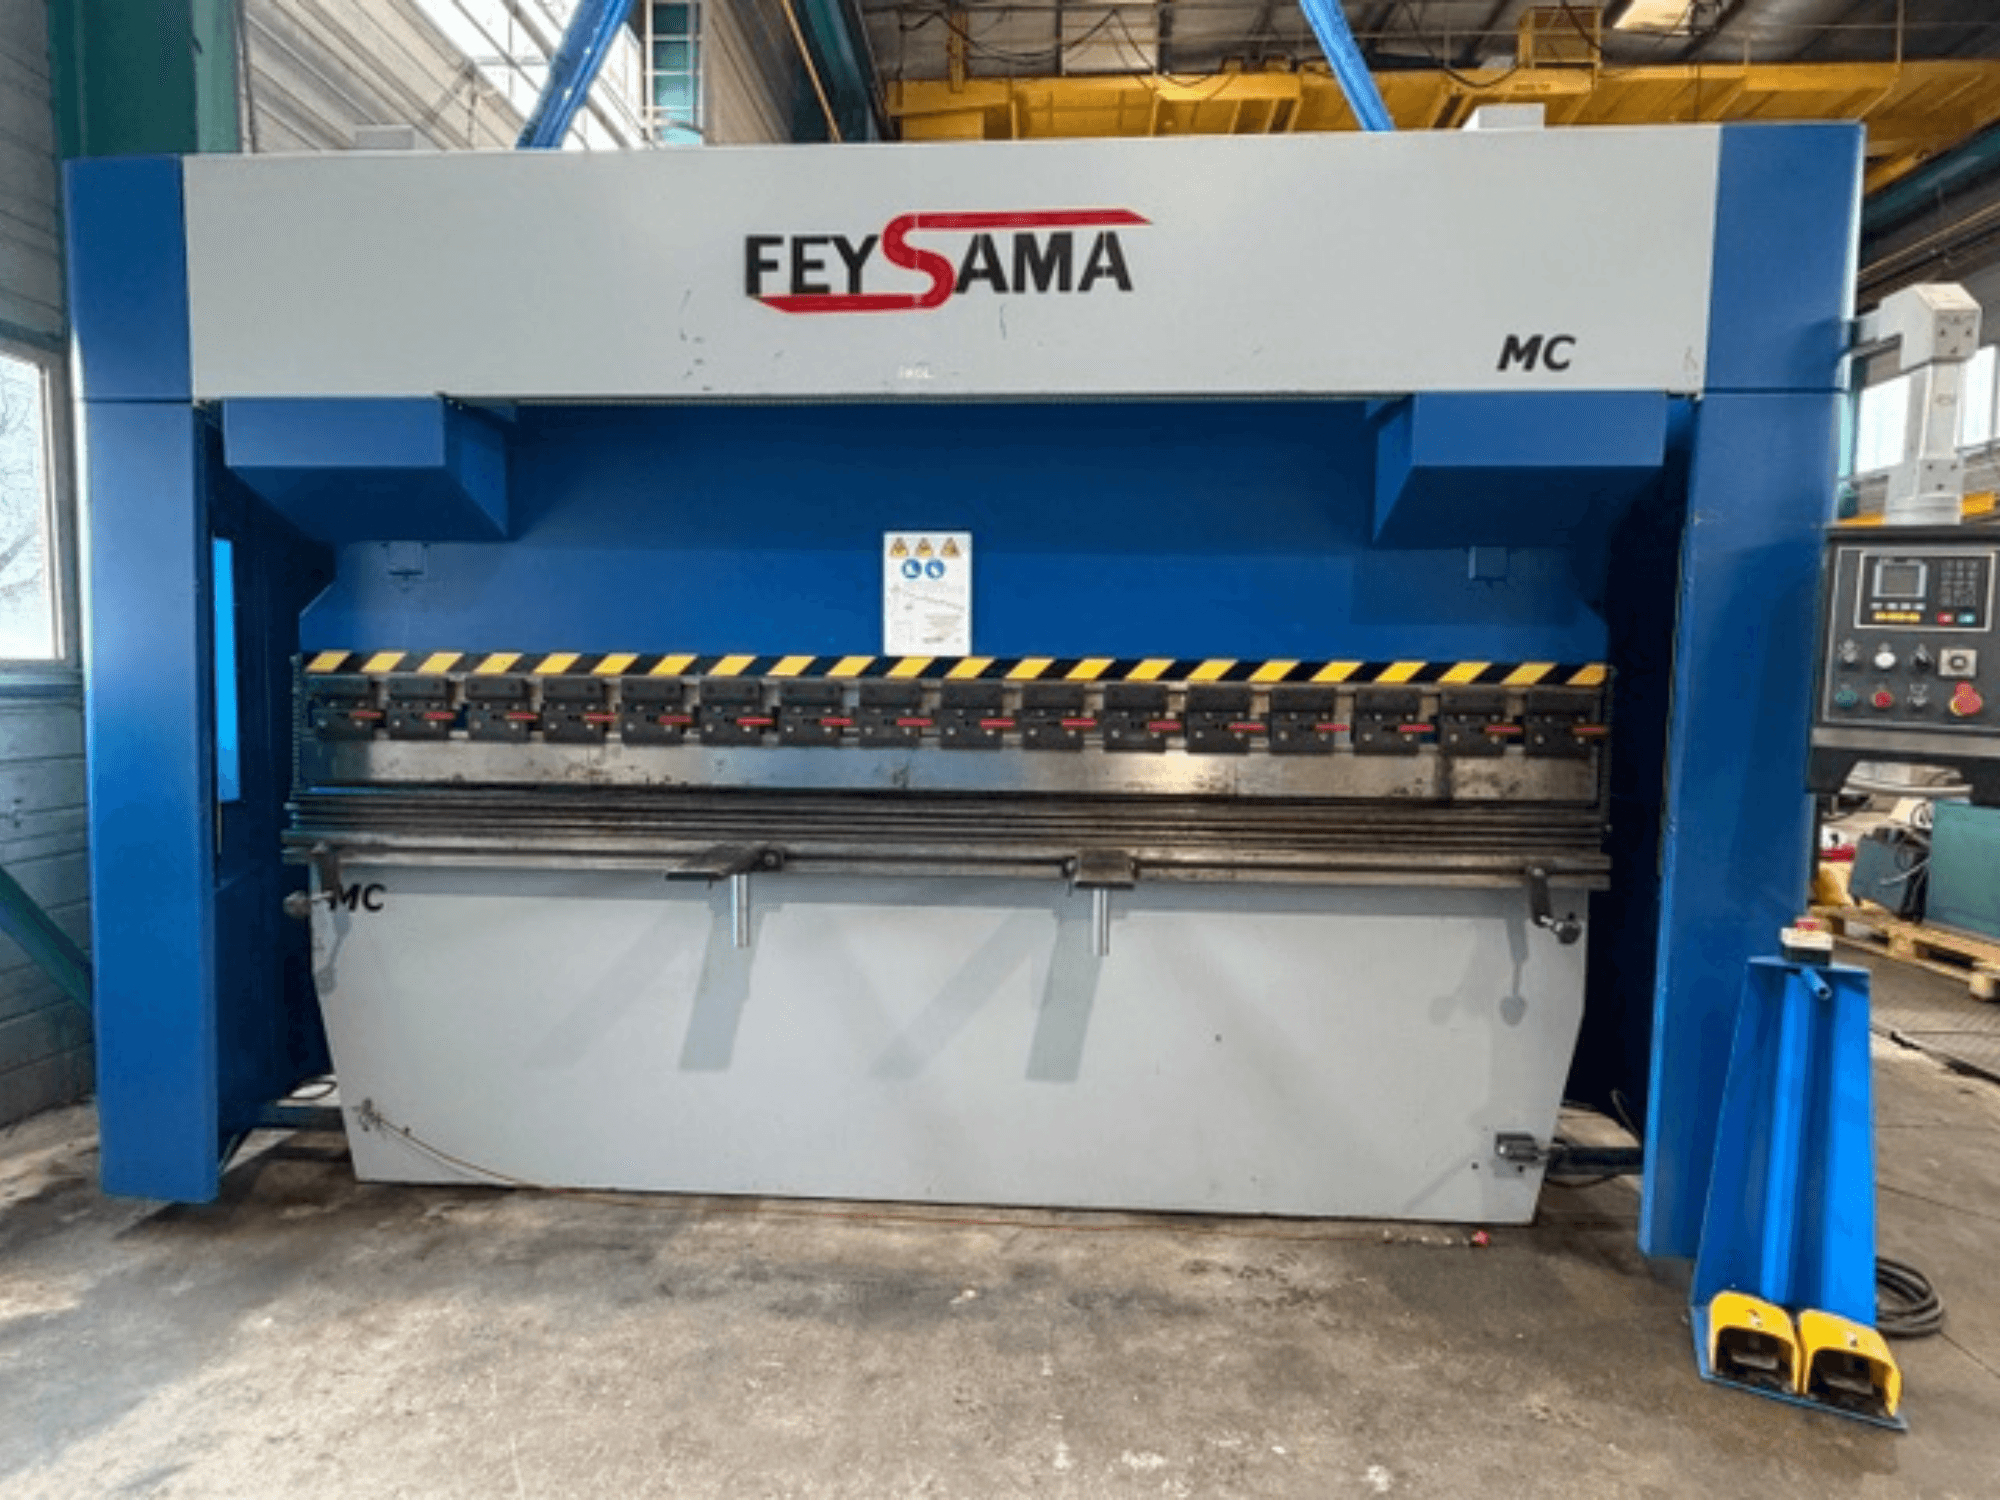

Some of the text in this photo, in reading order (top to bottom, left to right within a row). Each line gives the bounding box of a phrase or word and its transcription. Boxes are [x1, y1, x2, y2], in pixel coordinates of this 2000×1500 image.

[744, 209, 1151, 314] FEYSAMA
[1496, 333, 1577, 372] MC
[329, 882, 387, 912] MC
